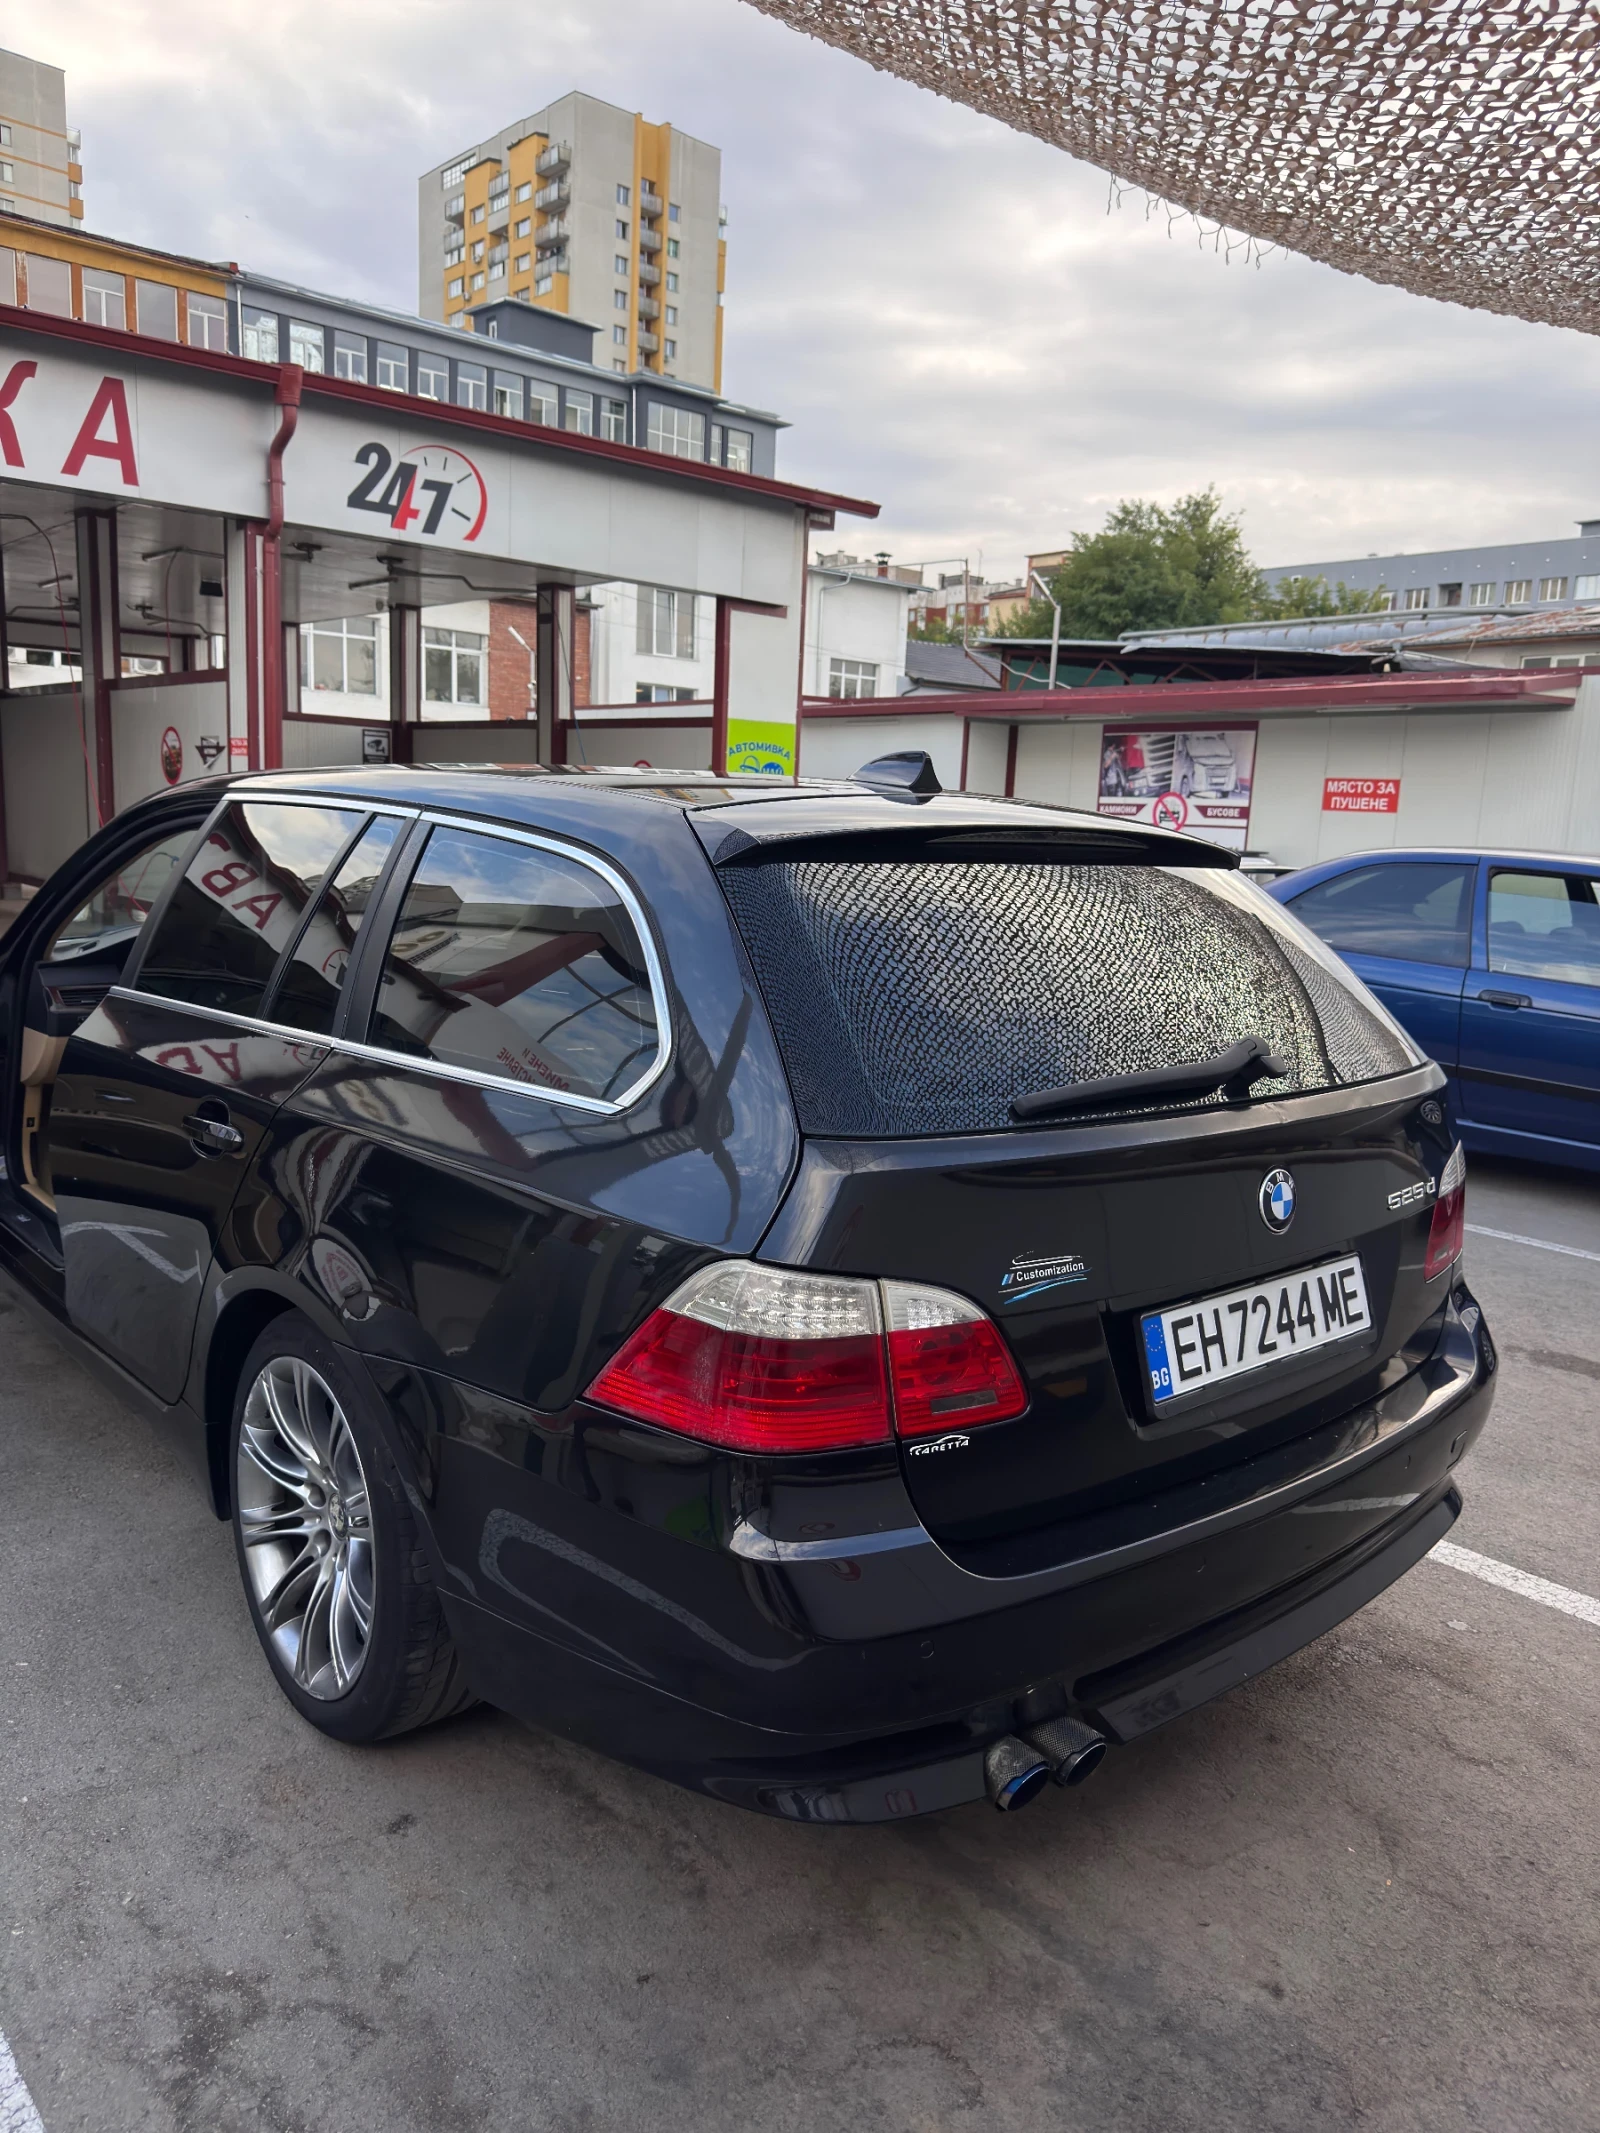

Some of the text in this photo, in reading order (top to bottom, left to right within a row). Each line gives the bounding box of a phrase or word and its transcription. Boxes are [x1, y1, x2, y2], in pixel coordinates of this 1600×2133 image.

[728, 742, 791, 761] АВТОМИВКА
[1326, 780, 1396, 795] МЯСТО ЗА
[1206, 807, 1240, 817] БУСОВЕ
[1330, 796, 1389, 811] ПУШЕНЕ
[1265, 1171, 1295, 1195] BMW
[1016, 1262, 1084, 1282] Customization
[1151, 1366, 1170, 1390] BG
